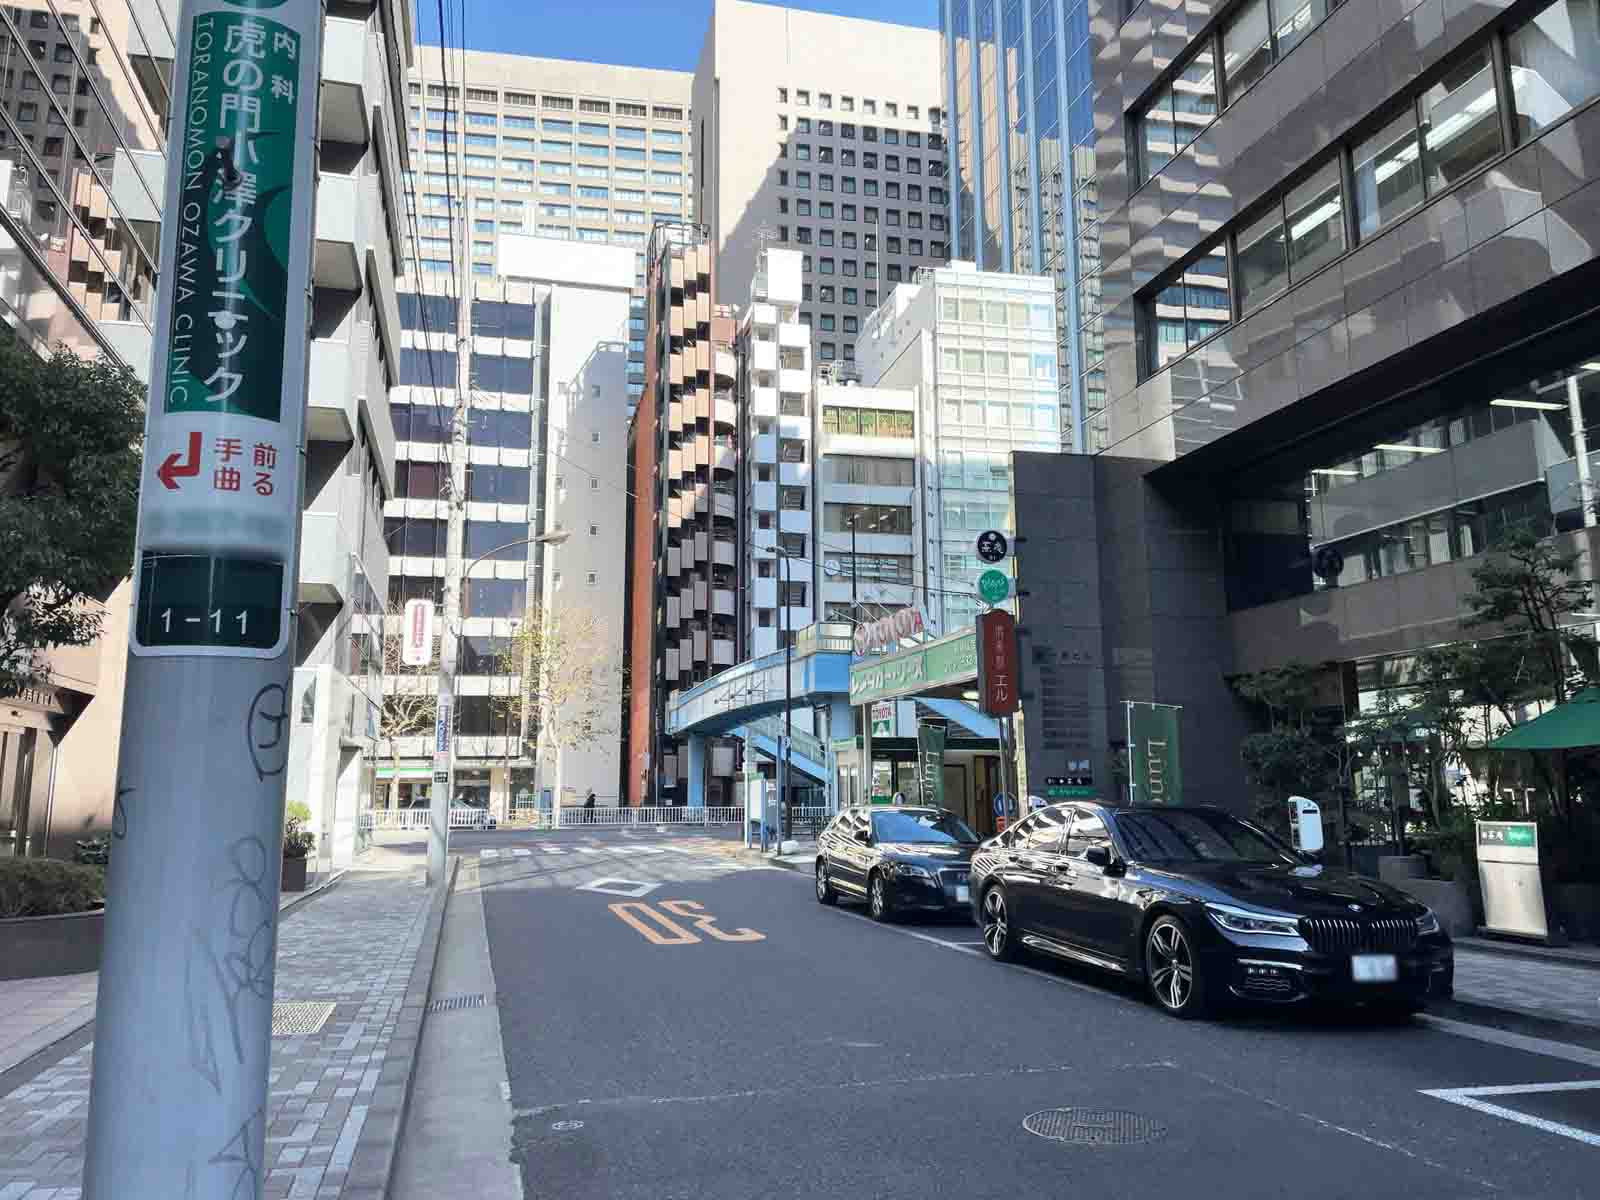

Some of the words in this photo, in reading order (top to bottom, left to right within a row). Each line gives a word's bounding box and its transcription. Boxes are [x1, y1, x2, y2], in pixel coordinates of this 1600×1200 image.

[184, 17, 214, 191] TORANOMON
[272, 31, 297, 105] 内科
[177, 202, 200, 302] OZAWA
[170, 314, 193, 403] CLINIC
